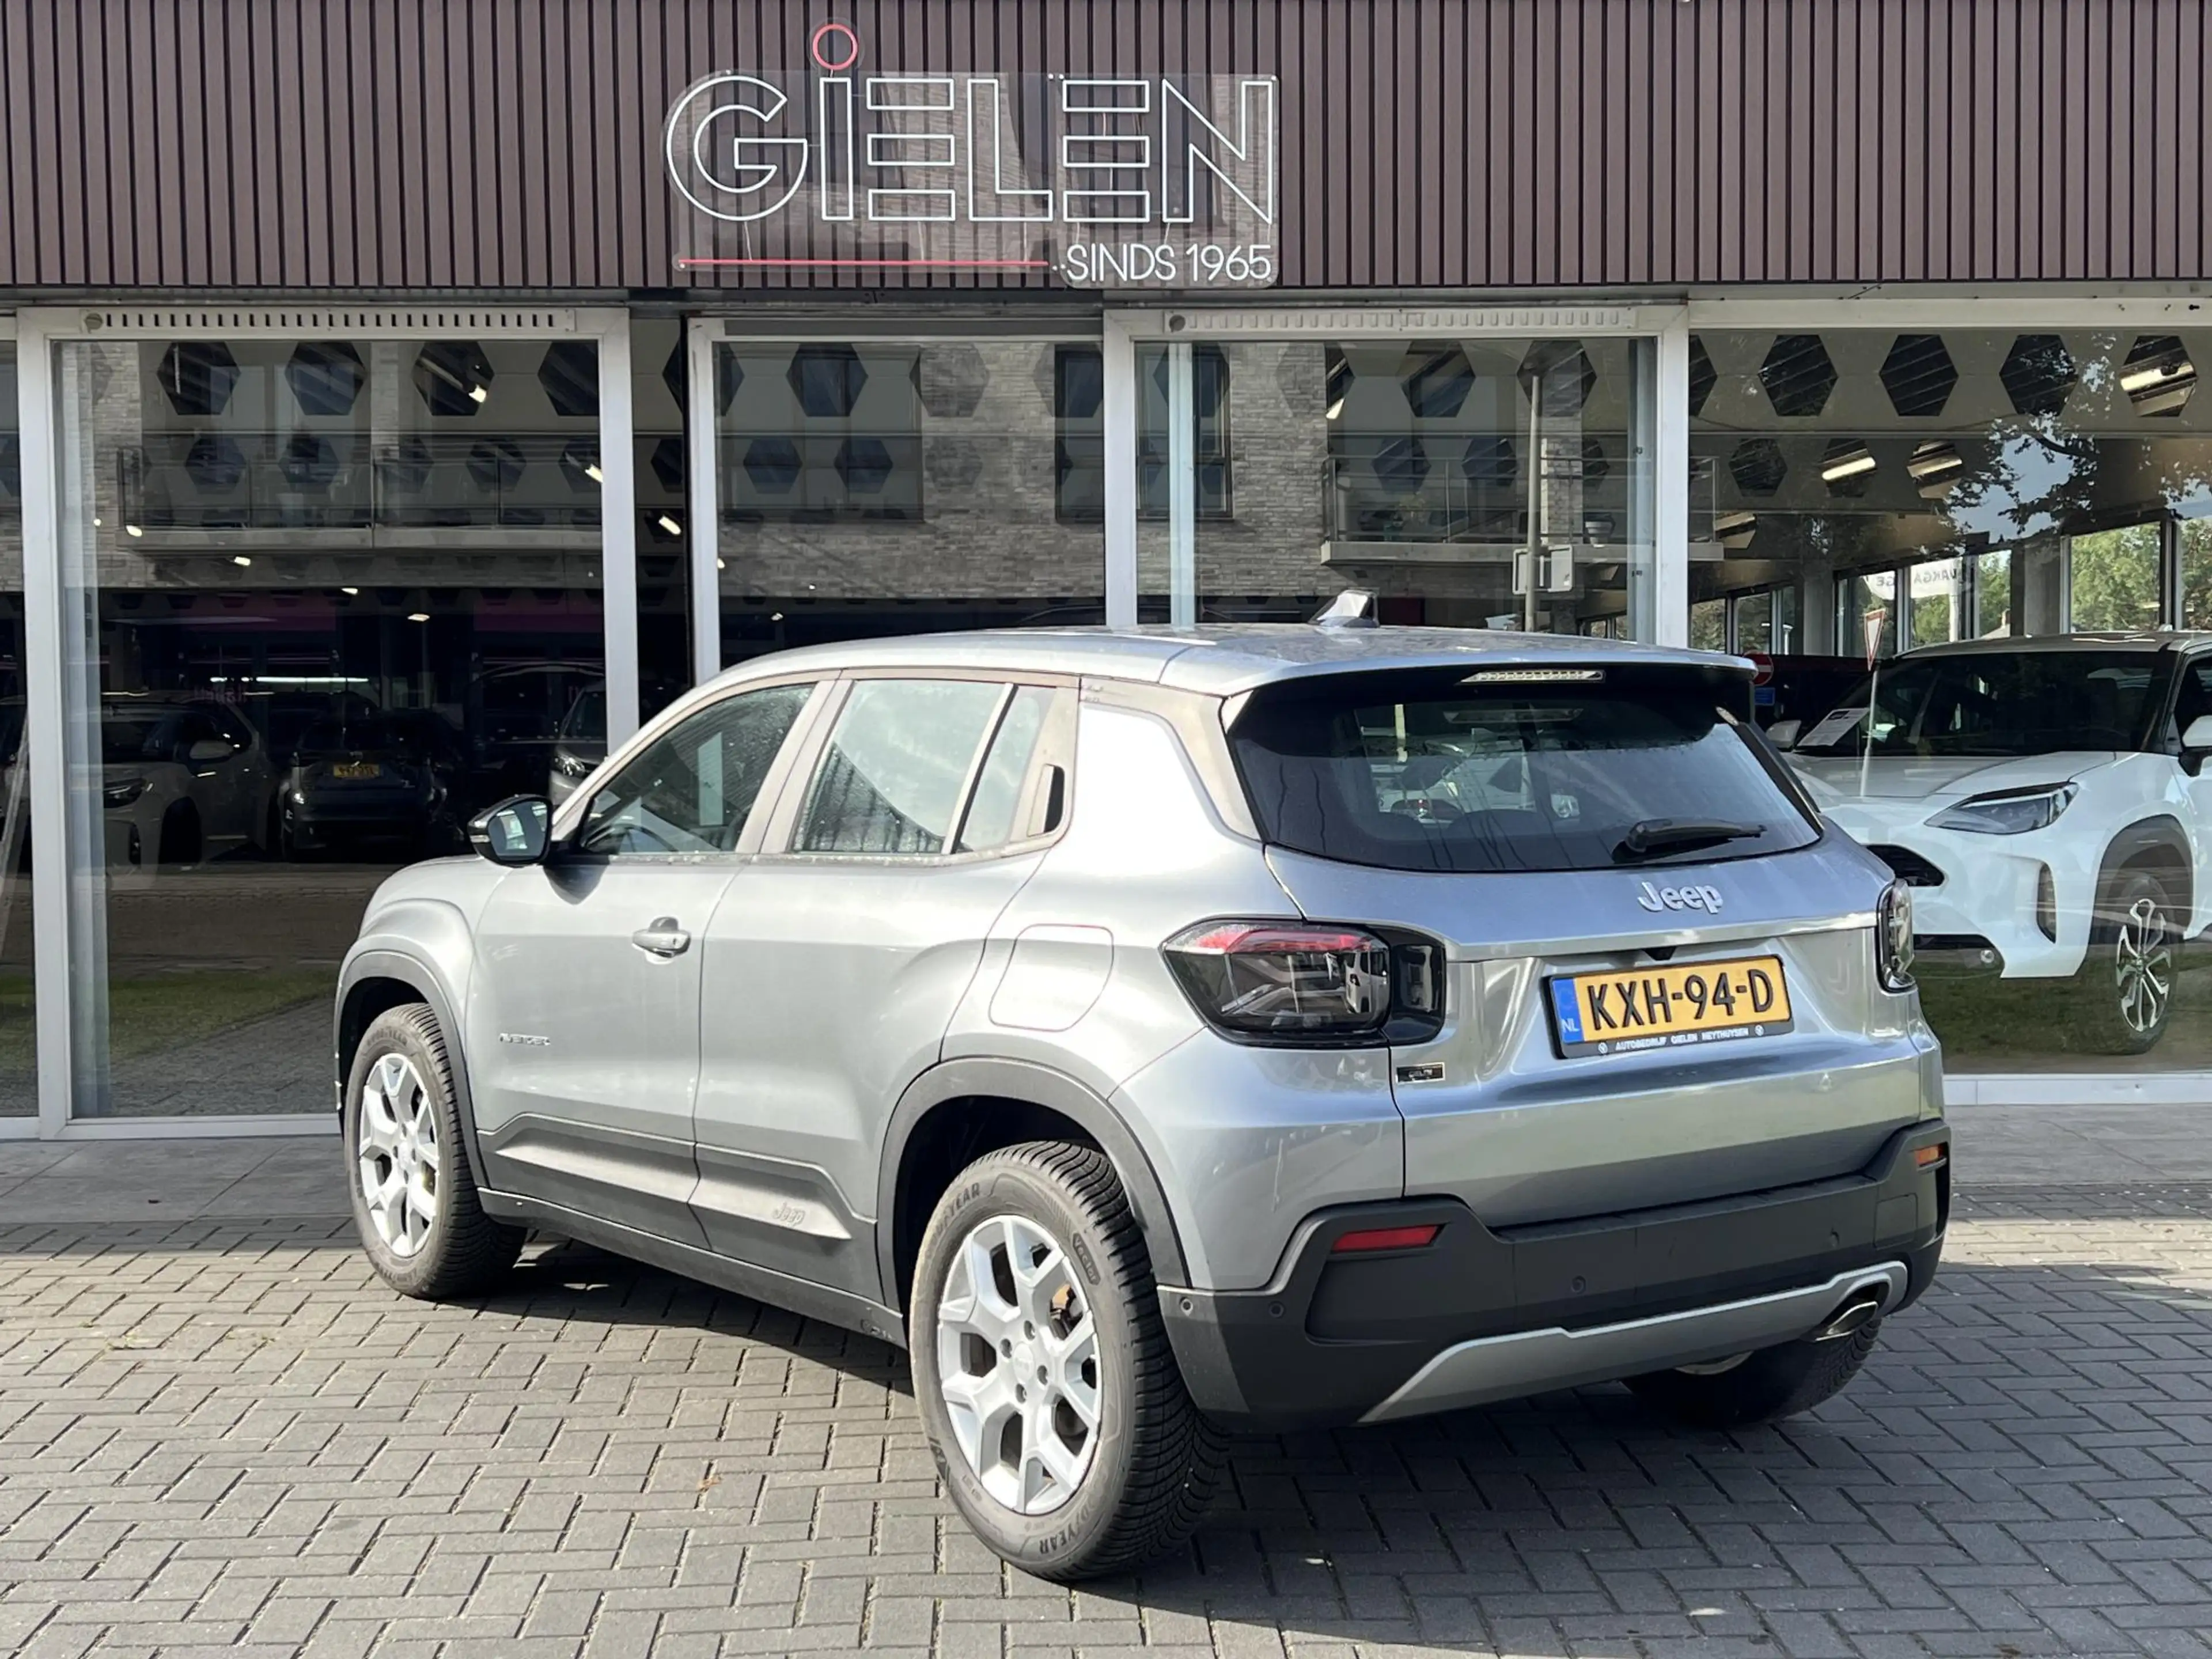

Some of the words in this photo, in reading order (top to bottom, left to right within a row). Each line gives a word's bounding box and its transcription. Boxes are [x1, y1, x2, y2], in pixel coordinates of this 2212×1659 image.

[1066, 243, 1176, 283] SINDS
[1185, 243, 1272, 282] 1965
[1637, 881, 1724, 914] Jeep
[1587, 968, 1774, 1031] KXH-94-D
[1561, 1017, 1580, 1033] NL
